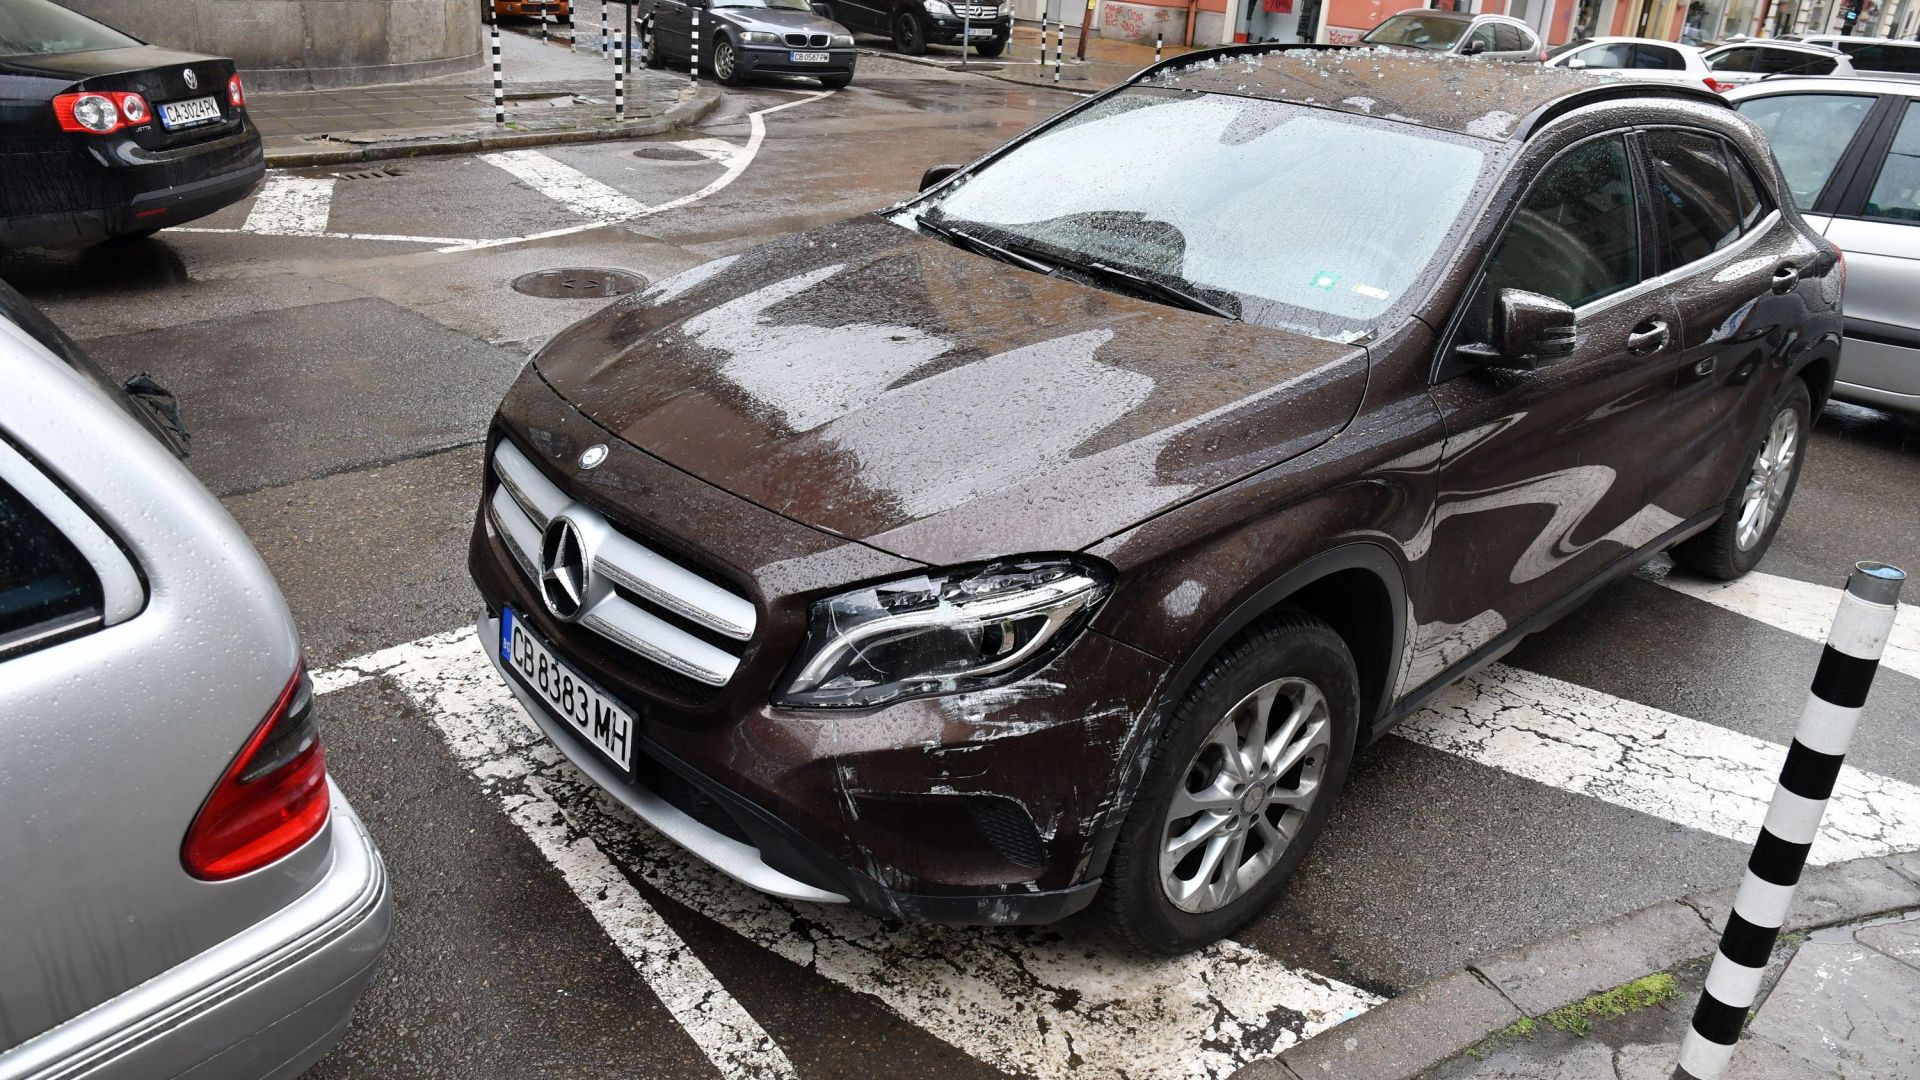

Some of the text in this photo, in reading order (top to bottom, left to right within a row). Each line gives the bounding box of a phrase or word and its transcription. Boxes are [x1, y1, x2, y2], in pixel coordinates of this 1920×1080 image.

[166, 98, 218, 122] CA 3024 PK
[136, 125, 151, 133] JETTA
[503, 637, 511, 654] BG
[513, 626, 627, 761] CB 8383 MH
